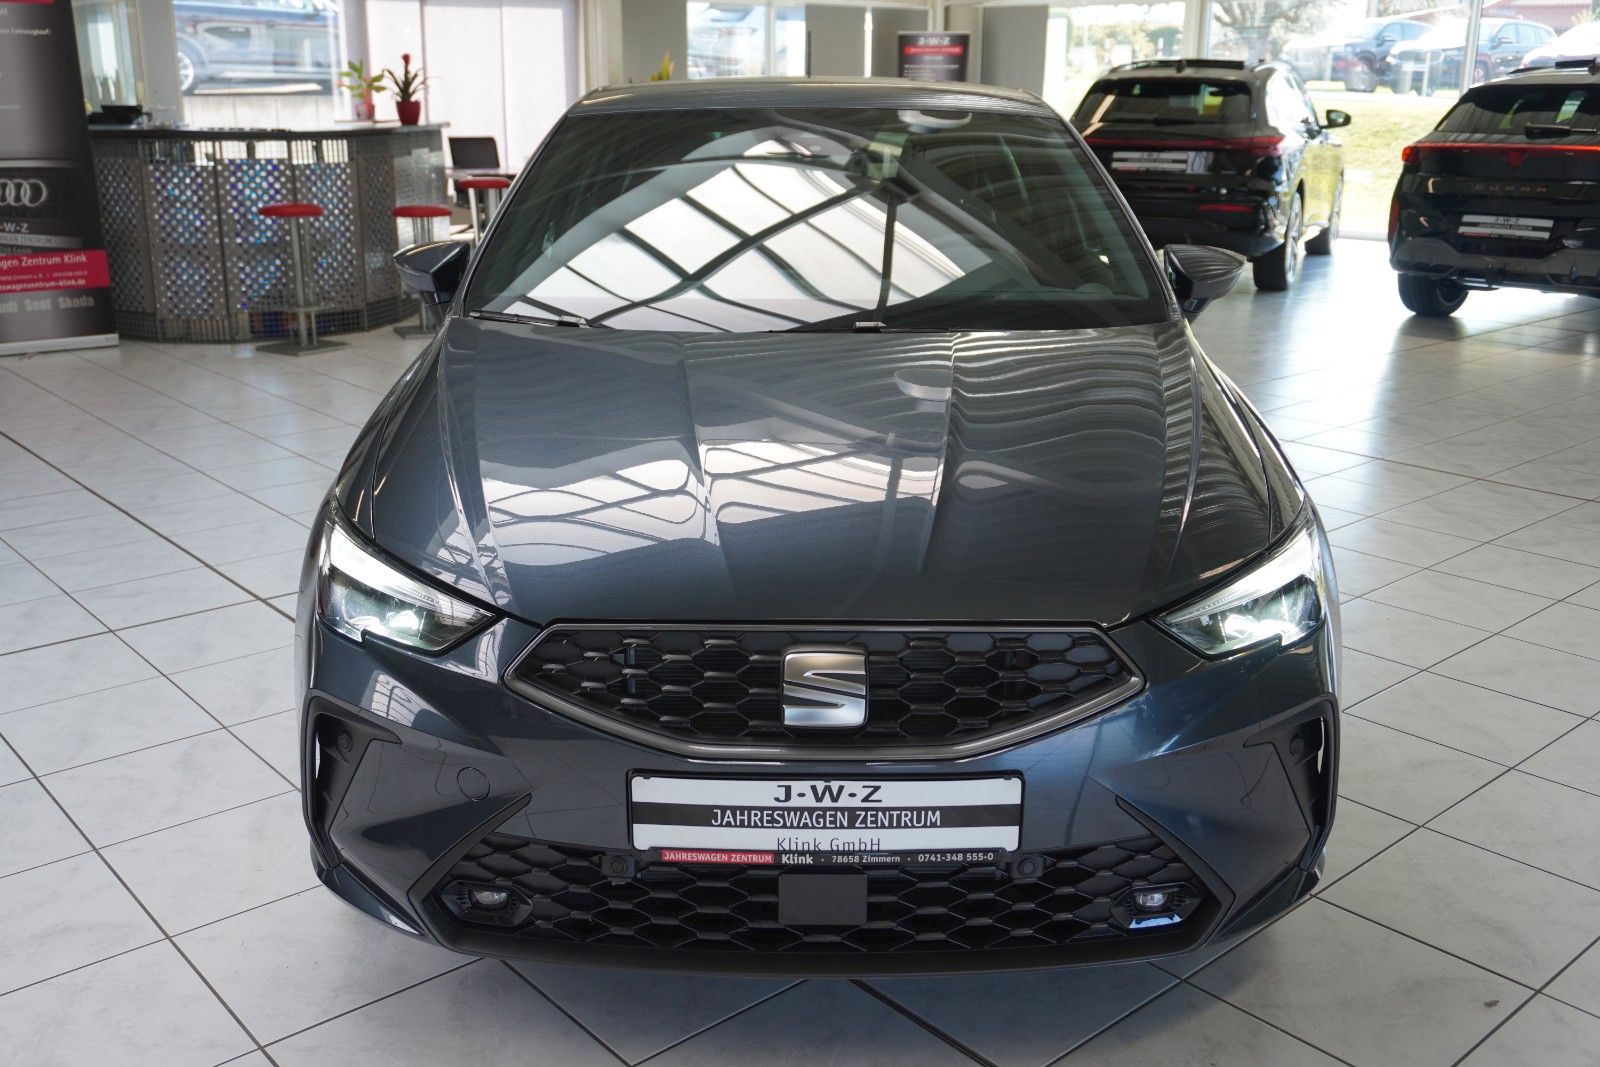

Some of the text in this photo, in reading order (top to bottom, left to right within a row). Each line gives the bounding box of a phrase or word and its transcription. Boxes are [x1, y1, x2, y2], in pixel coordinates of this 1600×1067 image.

[21, 256, 61, 267] Zentrum
[63, 253, 88, 264] Klink
[24, 298, 52, 312] Seat
[58, 295, 95, 309] Skoda
[711, 809, 941, 828] JAHRESWAGEN ZENTRUM
[777, 837, 881, 851] Klink GmbH
[664, 852, 994, 864] JAHRESWAGEN ZENTRUM Klink 78658 Zimmern 0741-348 555-0
